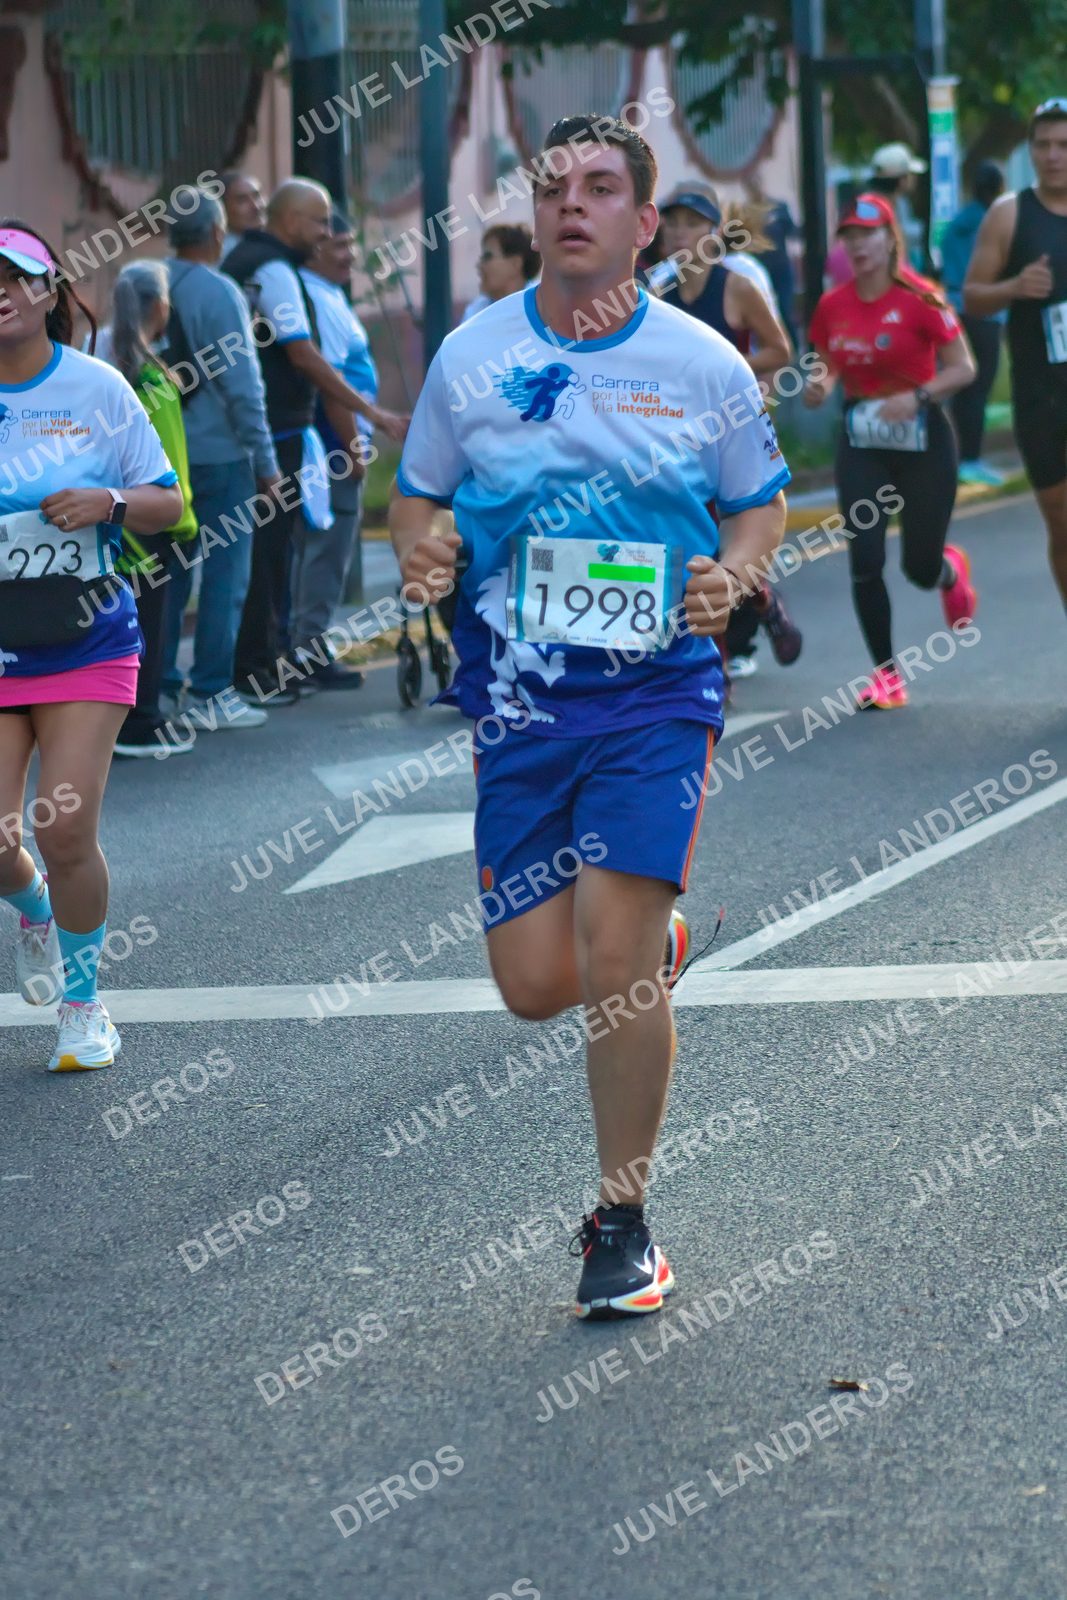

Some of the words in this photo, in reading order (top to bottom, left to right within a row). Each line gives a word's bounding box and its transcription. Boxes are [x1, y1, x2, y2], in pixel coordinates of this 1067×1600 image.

[592, 374, 659, 391] Carrera
[592, 391, 612, 404] por
[617, 390, 627, 402] la
[631, 391, 660, 404] Vida
[21, 409, 71, 419] Carrera
[592, 402, 599, 415] y
[602, 401, 612, 412] la
[617, 402, 683, 418] Integridad
[50, 418, 72, 427] Vida
[40, 426, 90, 437] Integridad
[8, 540, 82, 581] 223
[535, 583, 657, 634] 1998
